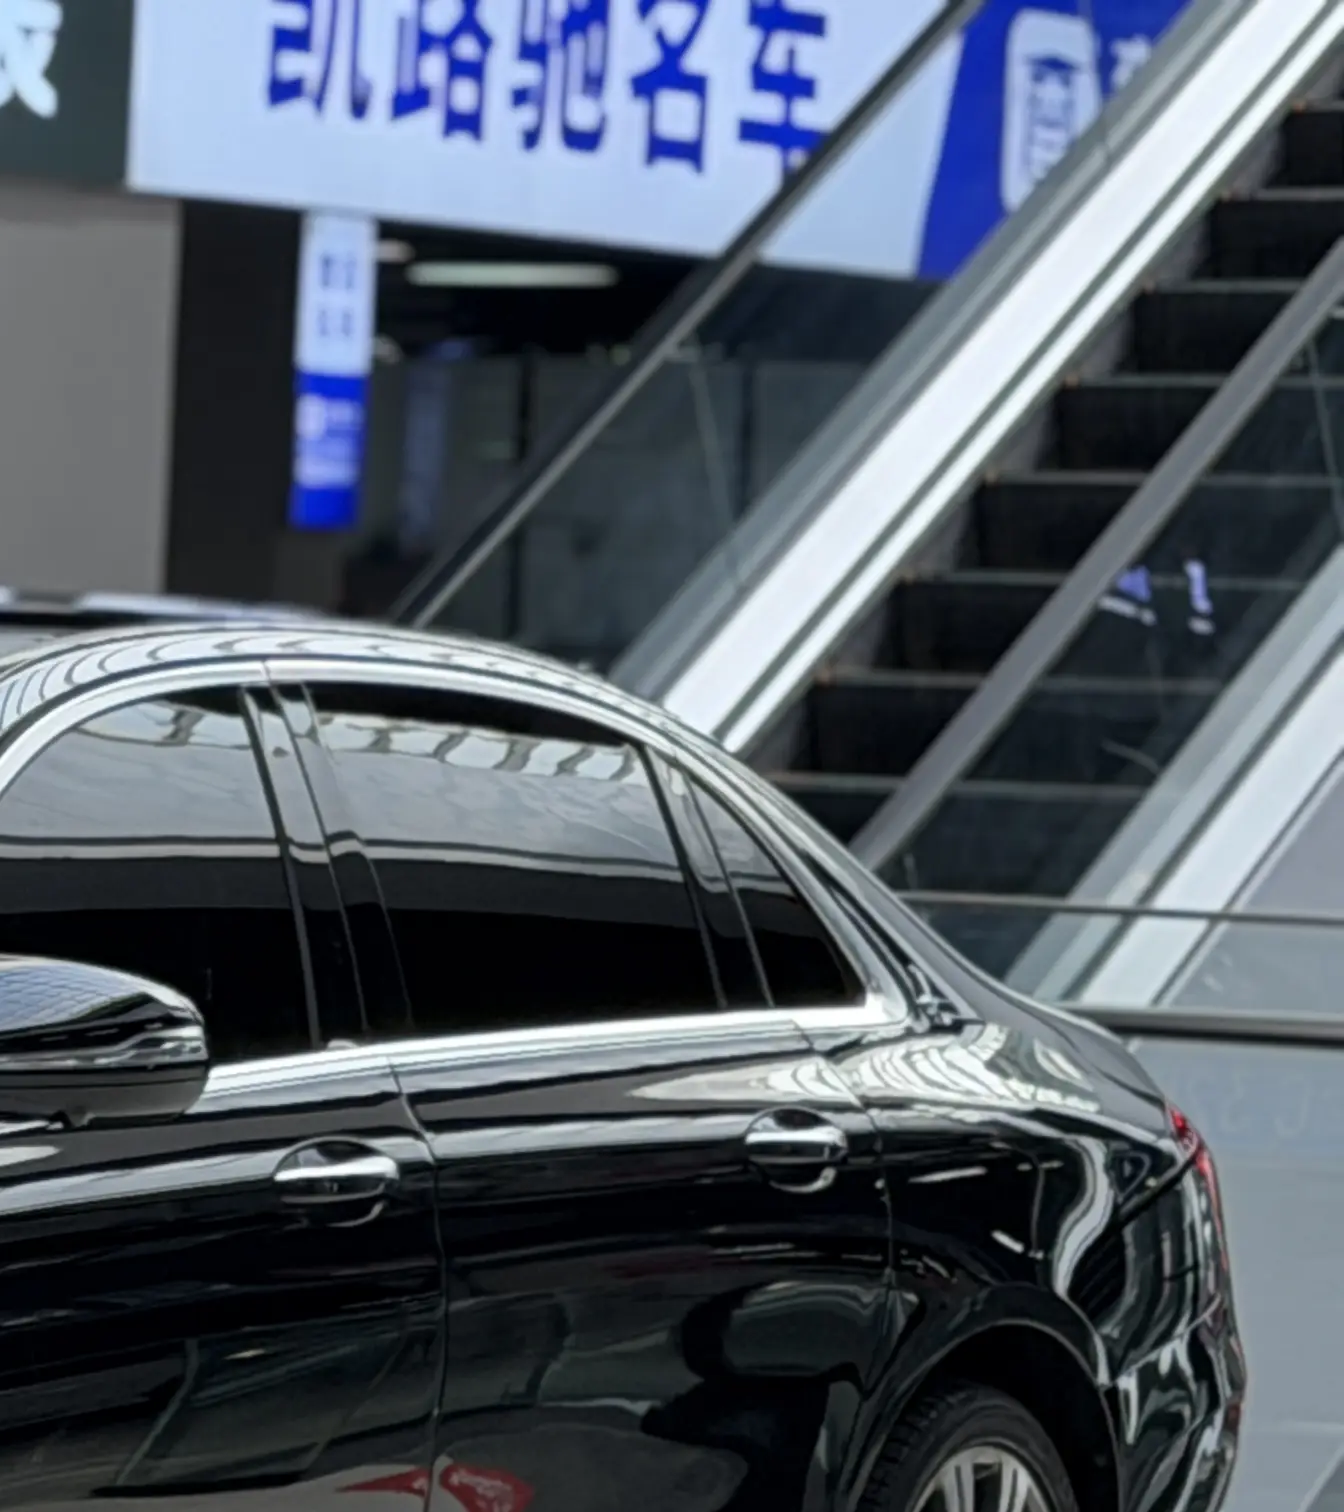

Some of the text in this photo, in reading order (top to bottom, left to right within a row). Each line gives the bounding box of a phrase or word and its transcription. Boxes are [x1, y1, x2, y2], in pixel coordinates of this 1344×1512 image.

[267, 0, 832, 174] 凯路驰名车
